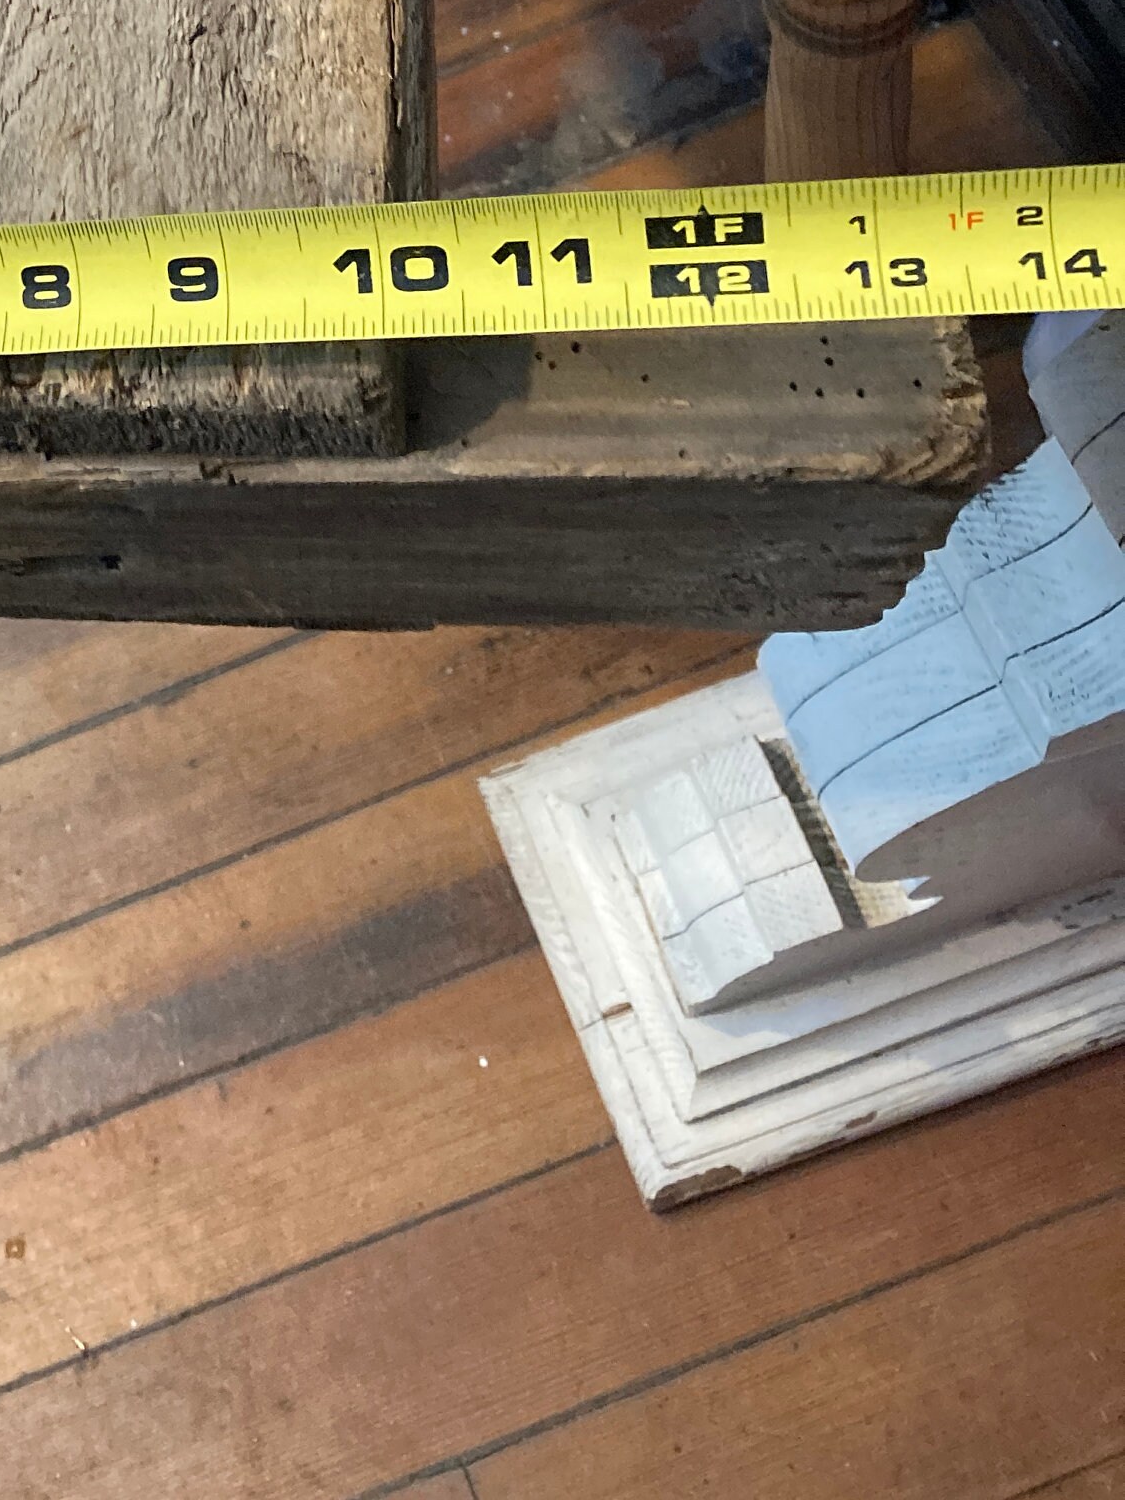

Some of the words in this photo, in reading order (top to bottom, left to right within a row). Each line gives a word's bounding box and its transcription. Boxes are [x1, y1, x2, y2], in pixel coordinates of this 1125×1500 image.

[849, 215, 867, 235] 1
[1016, 205, 1044, 227] 2
[20, 264, 73, 309] 8
[167, 256, 219, 302] 9
[333, 245, 449, 294] 10
[491, 238, 593, 287] 11
[676, 265, 752, 293] 12
[844, 257, 928, 289] 13
[1018, 248, 1107, 280] 14
